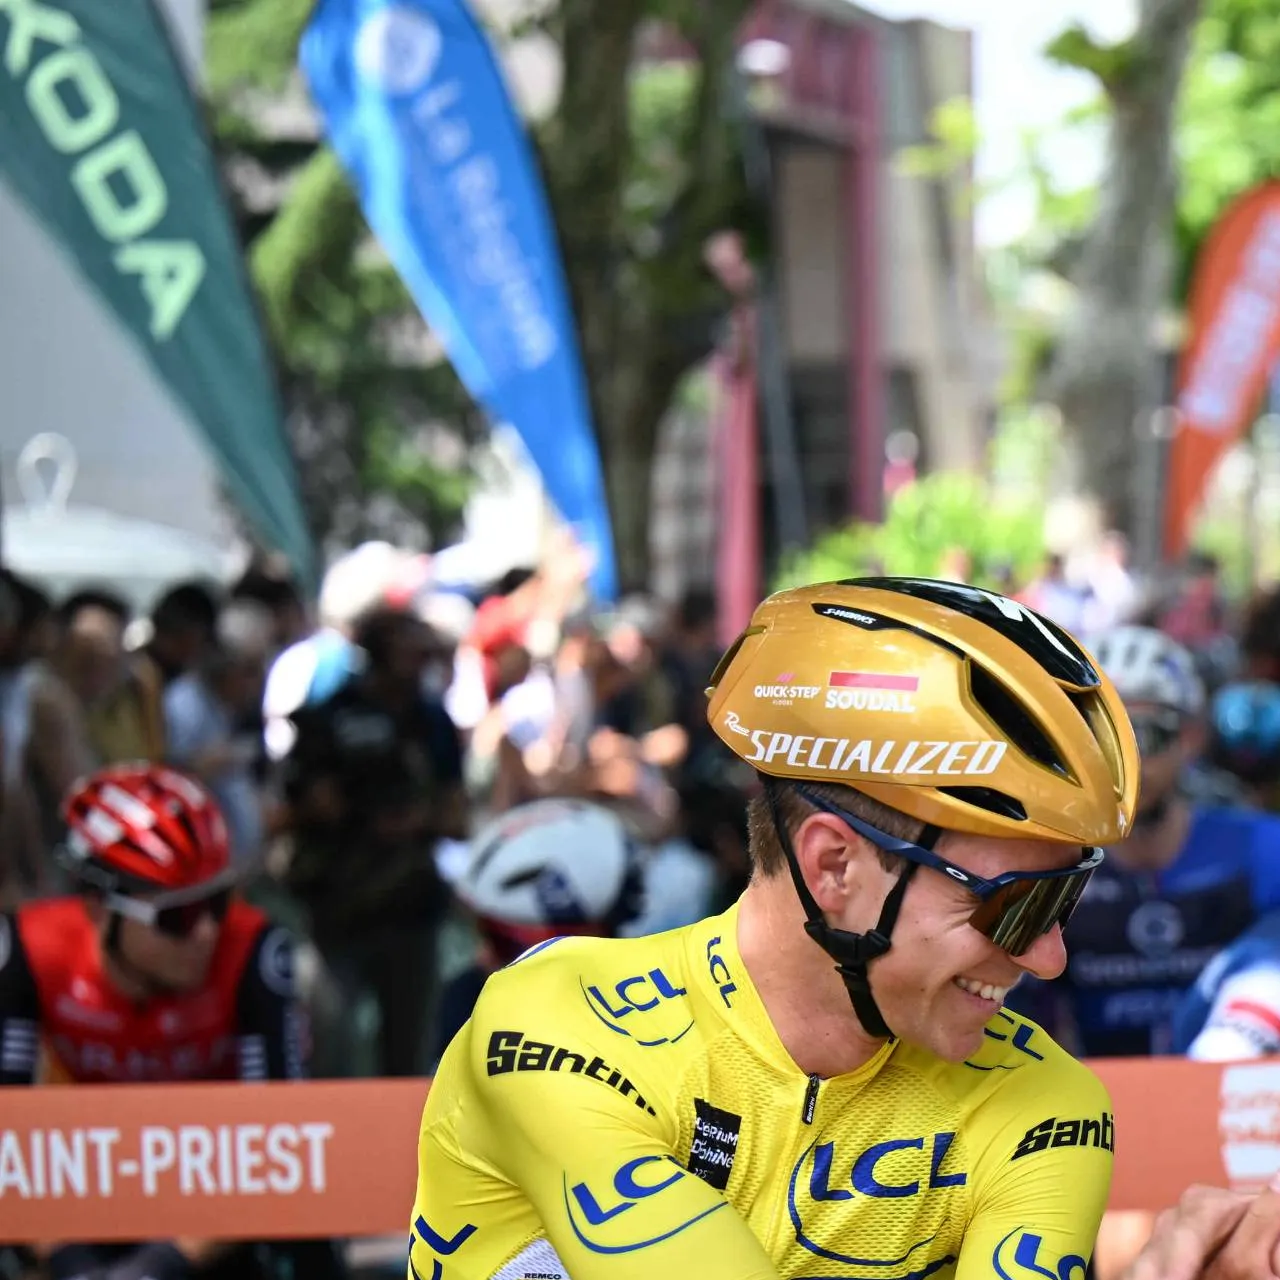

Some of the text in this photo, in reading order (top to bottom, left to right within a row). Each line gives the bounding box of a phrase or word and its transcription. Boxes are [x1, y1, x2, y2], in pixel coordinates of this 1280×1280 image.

[825, 689, 916, 713] SOUDAL
[745, 730, 1008, 775] SPECIALIZED
[587, 968, 687, 1018] LCL
[707, 936, 737, 1008] LCL
[809, 1131, 968, 1201] LCL
[524, 1273, 562, 1280] REMCO
